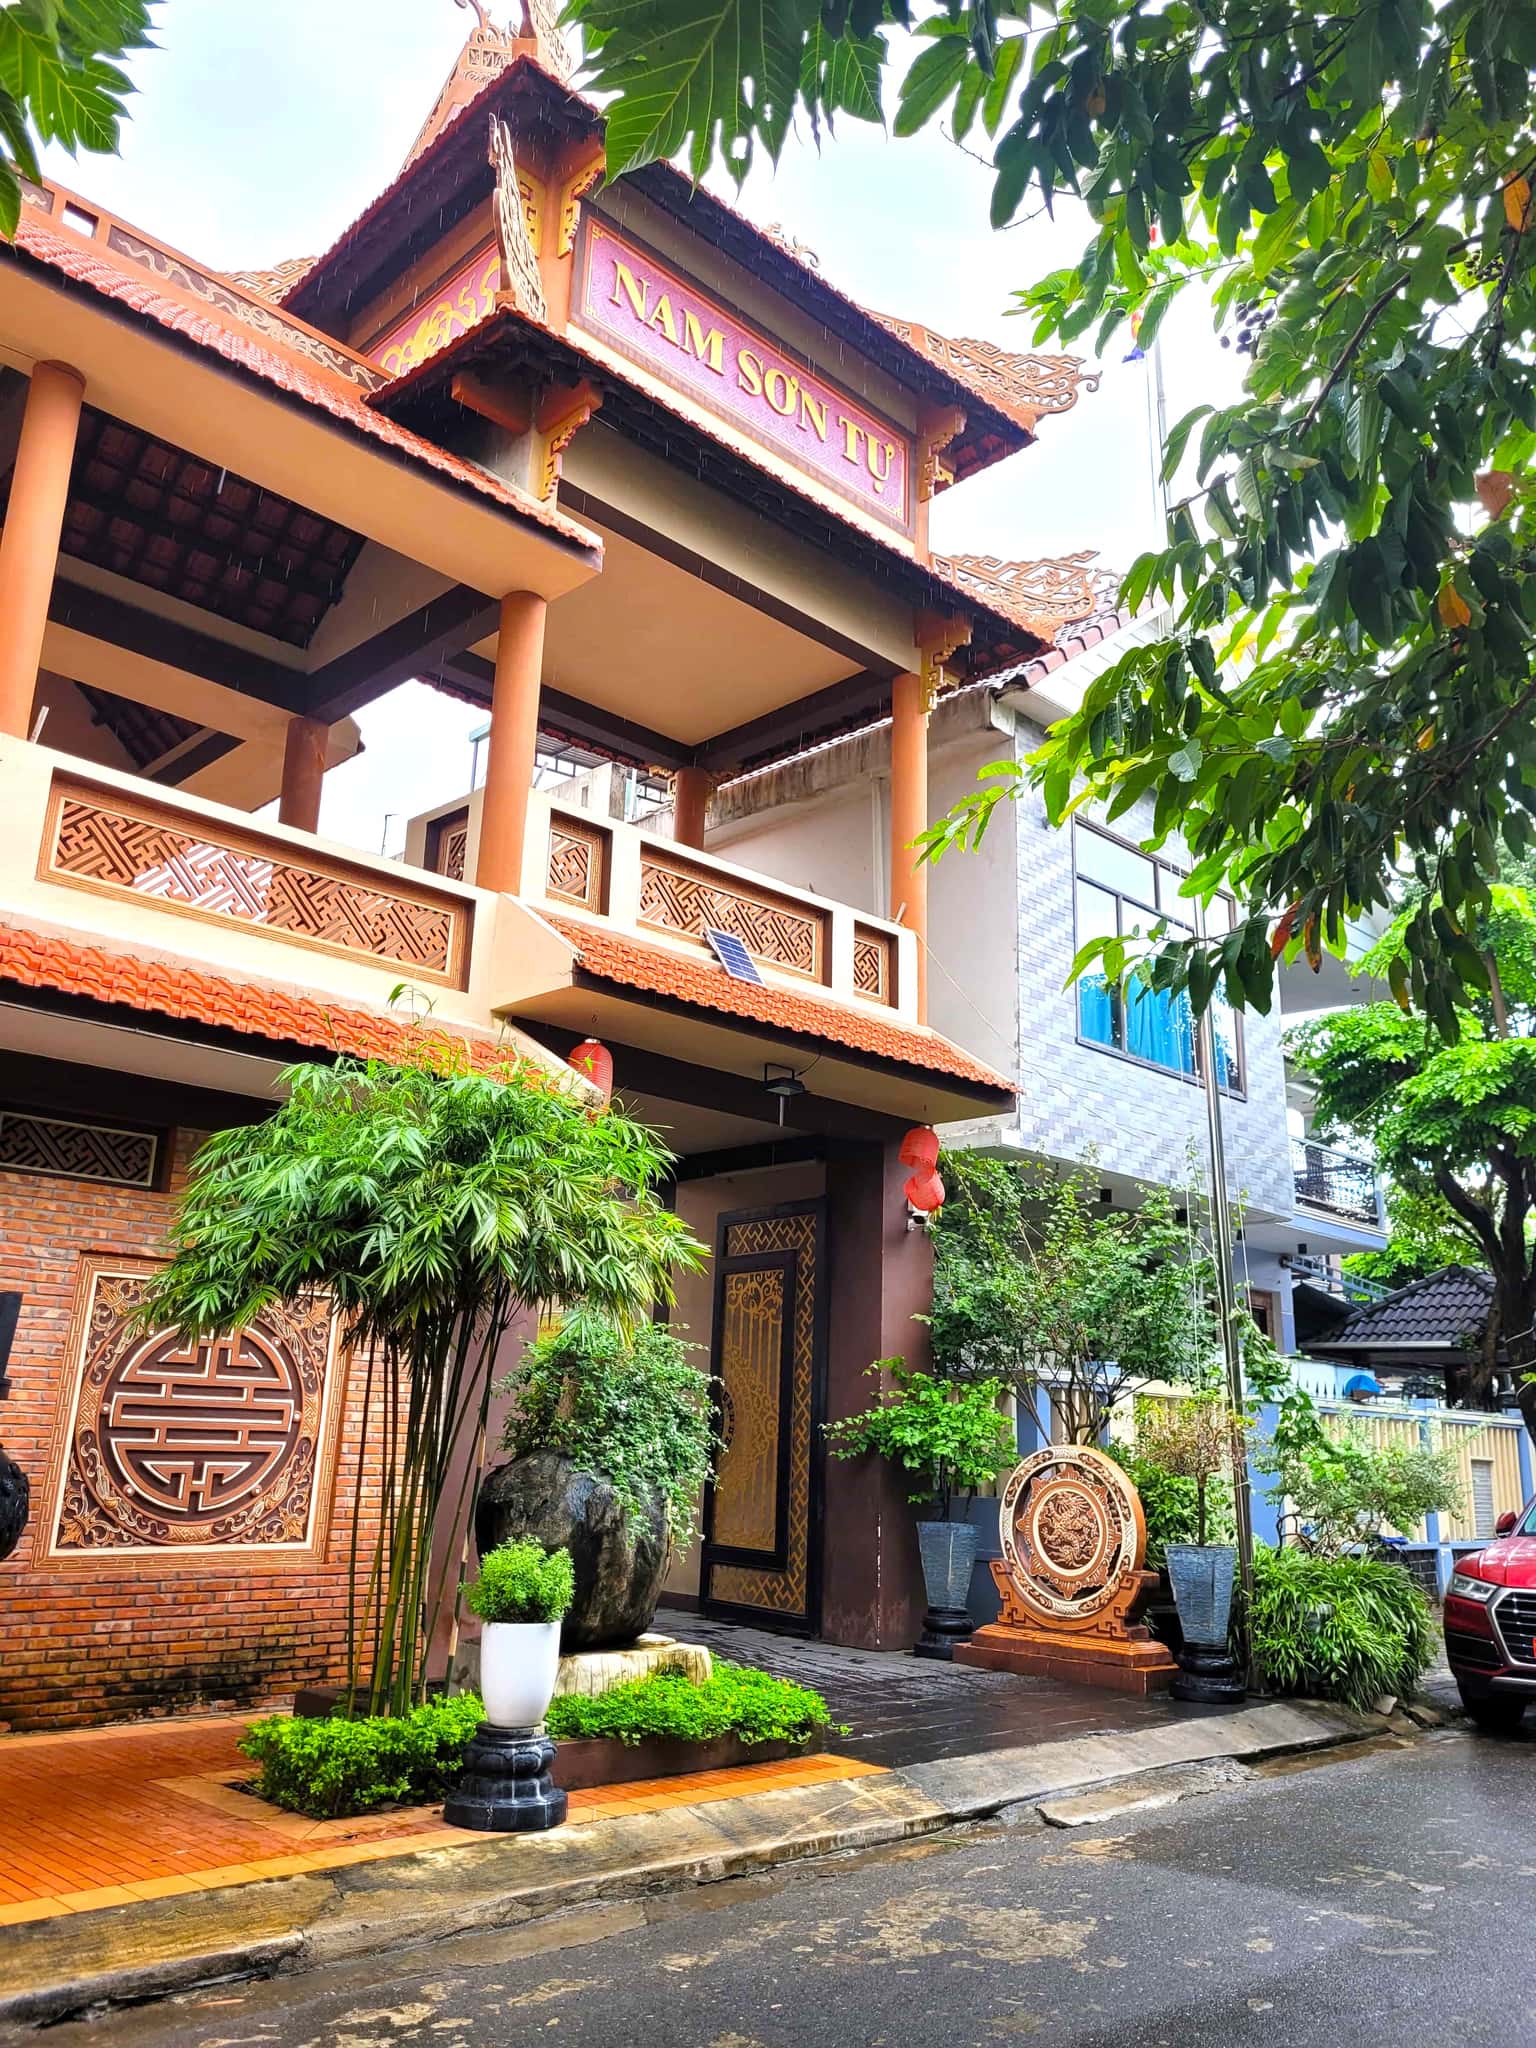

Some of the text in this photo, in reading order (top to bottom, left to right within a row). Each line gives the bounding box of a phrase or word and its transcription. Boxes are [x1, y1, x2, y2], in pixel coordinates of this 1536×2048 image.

[610, 260, 895, 493] NAM SƠN TỰ
